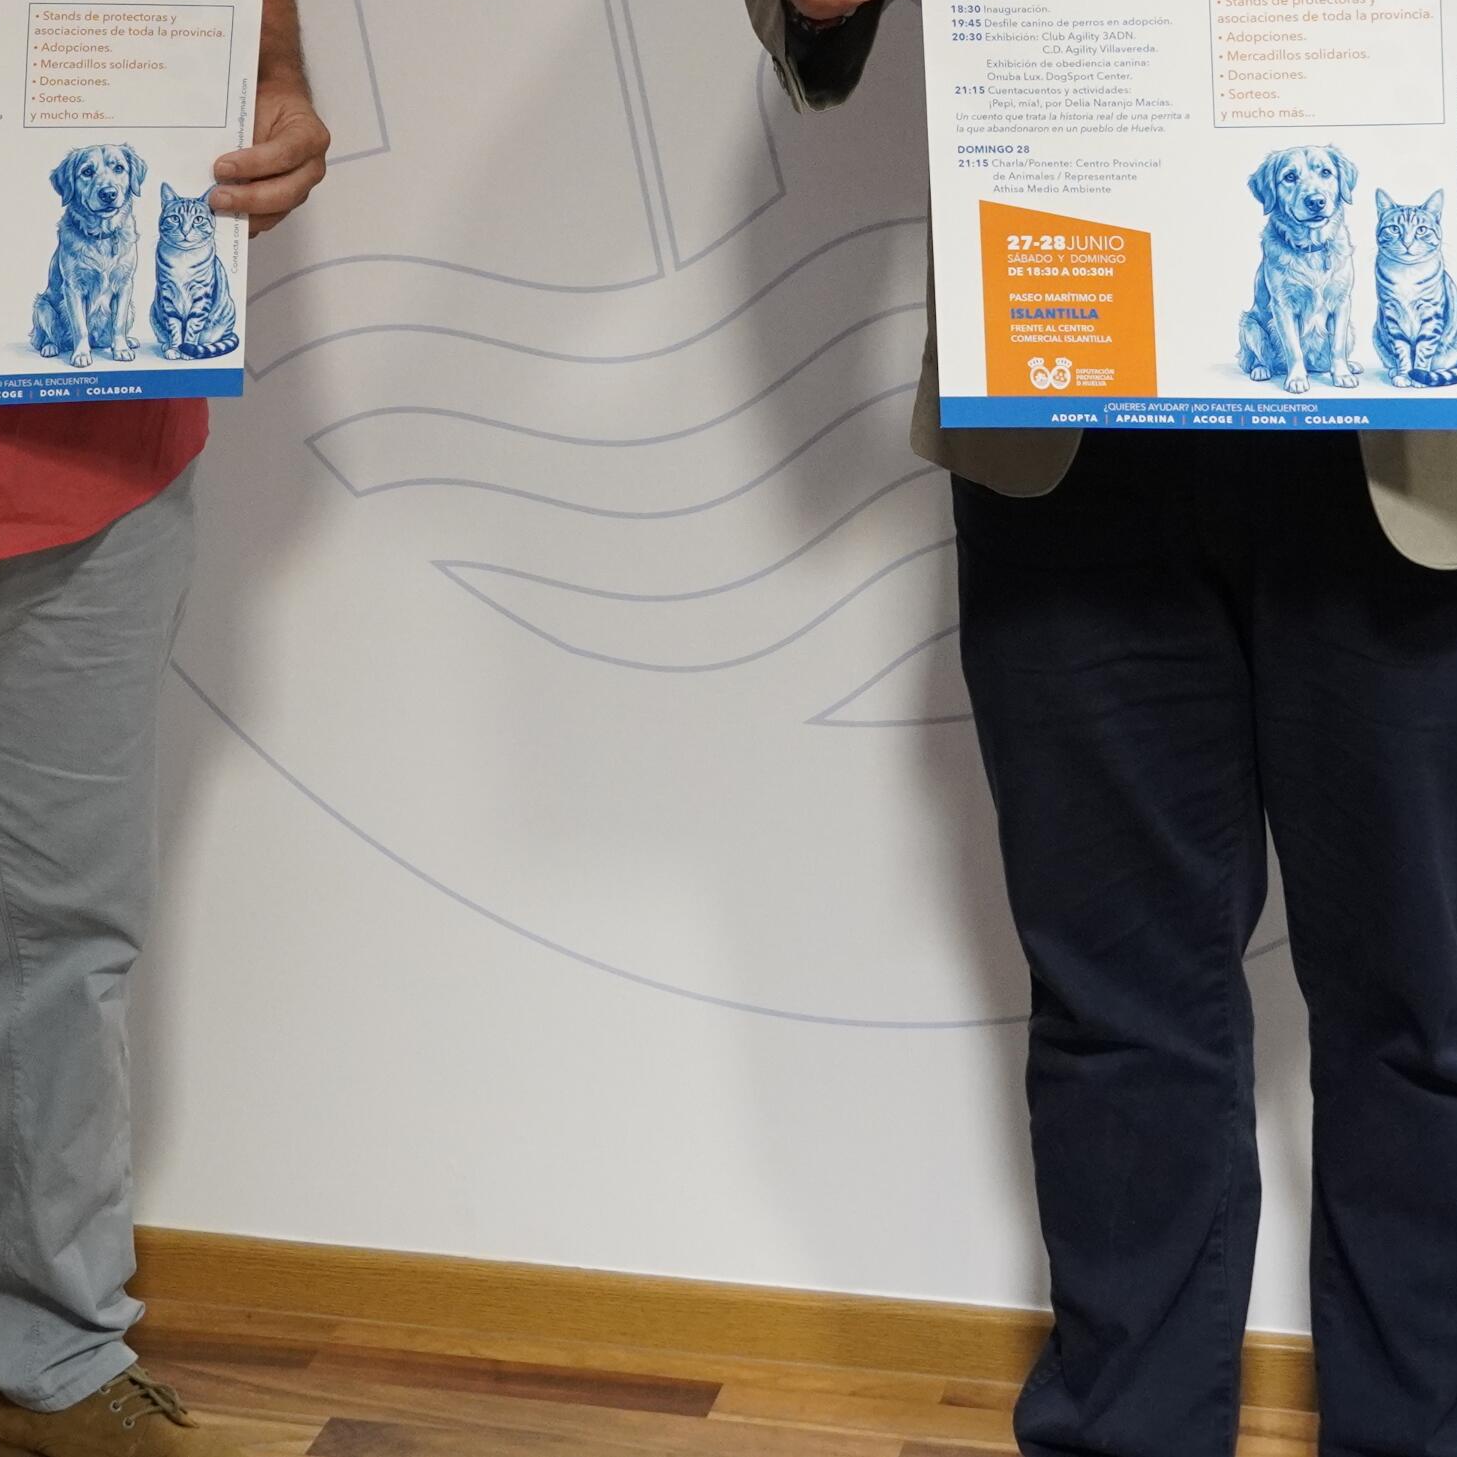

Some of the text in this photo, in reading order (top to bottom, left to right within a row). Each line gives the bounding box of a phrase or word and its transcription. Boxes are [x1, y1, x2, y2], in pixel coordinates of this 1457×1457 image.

[1224, 30, 1306, 45] Adopciones.
[40, 41, 112, 54] Adopciones.
[1226, 47, 1370, 62] Mercadillos solidarios.
[40, 58, 166, 70] Mercadillos solidarios.
[39, 75, 109, 86] Donaciones.
[1227, 69, 1306, 80] Donaciones.
[38, 92, 84, 103] Sorteos.
[1228, 88, 1280, 100] Sorteos.
[1008, 291, 1113, 302] PASEO MARÍTIMO DE
[1010, 307, 1099, 319] ISLANTILLA
[39, 388, 70, 397] DONA
[86, 385, 142, 395] COLABORA
[1103, 402, 1318, 413] ¿QUIERES AYUDAR? ¡NO FALTES AL ENCUENTRO!
[1051, 413, 1369, 424] ADOPTA APADRINA ACOGE DONA COLABORA
